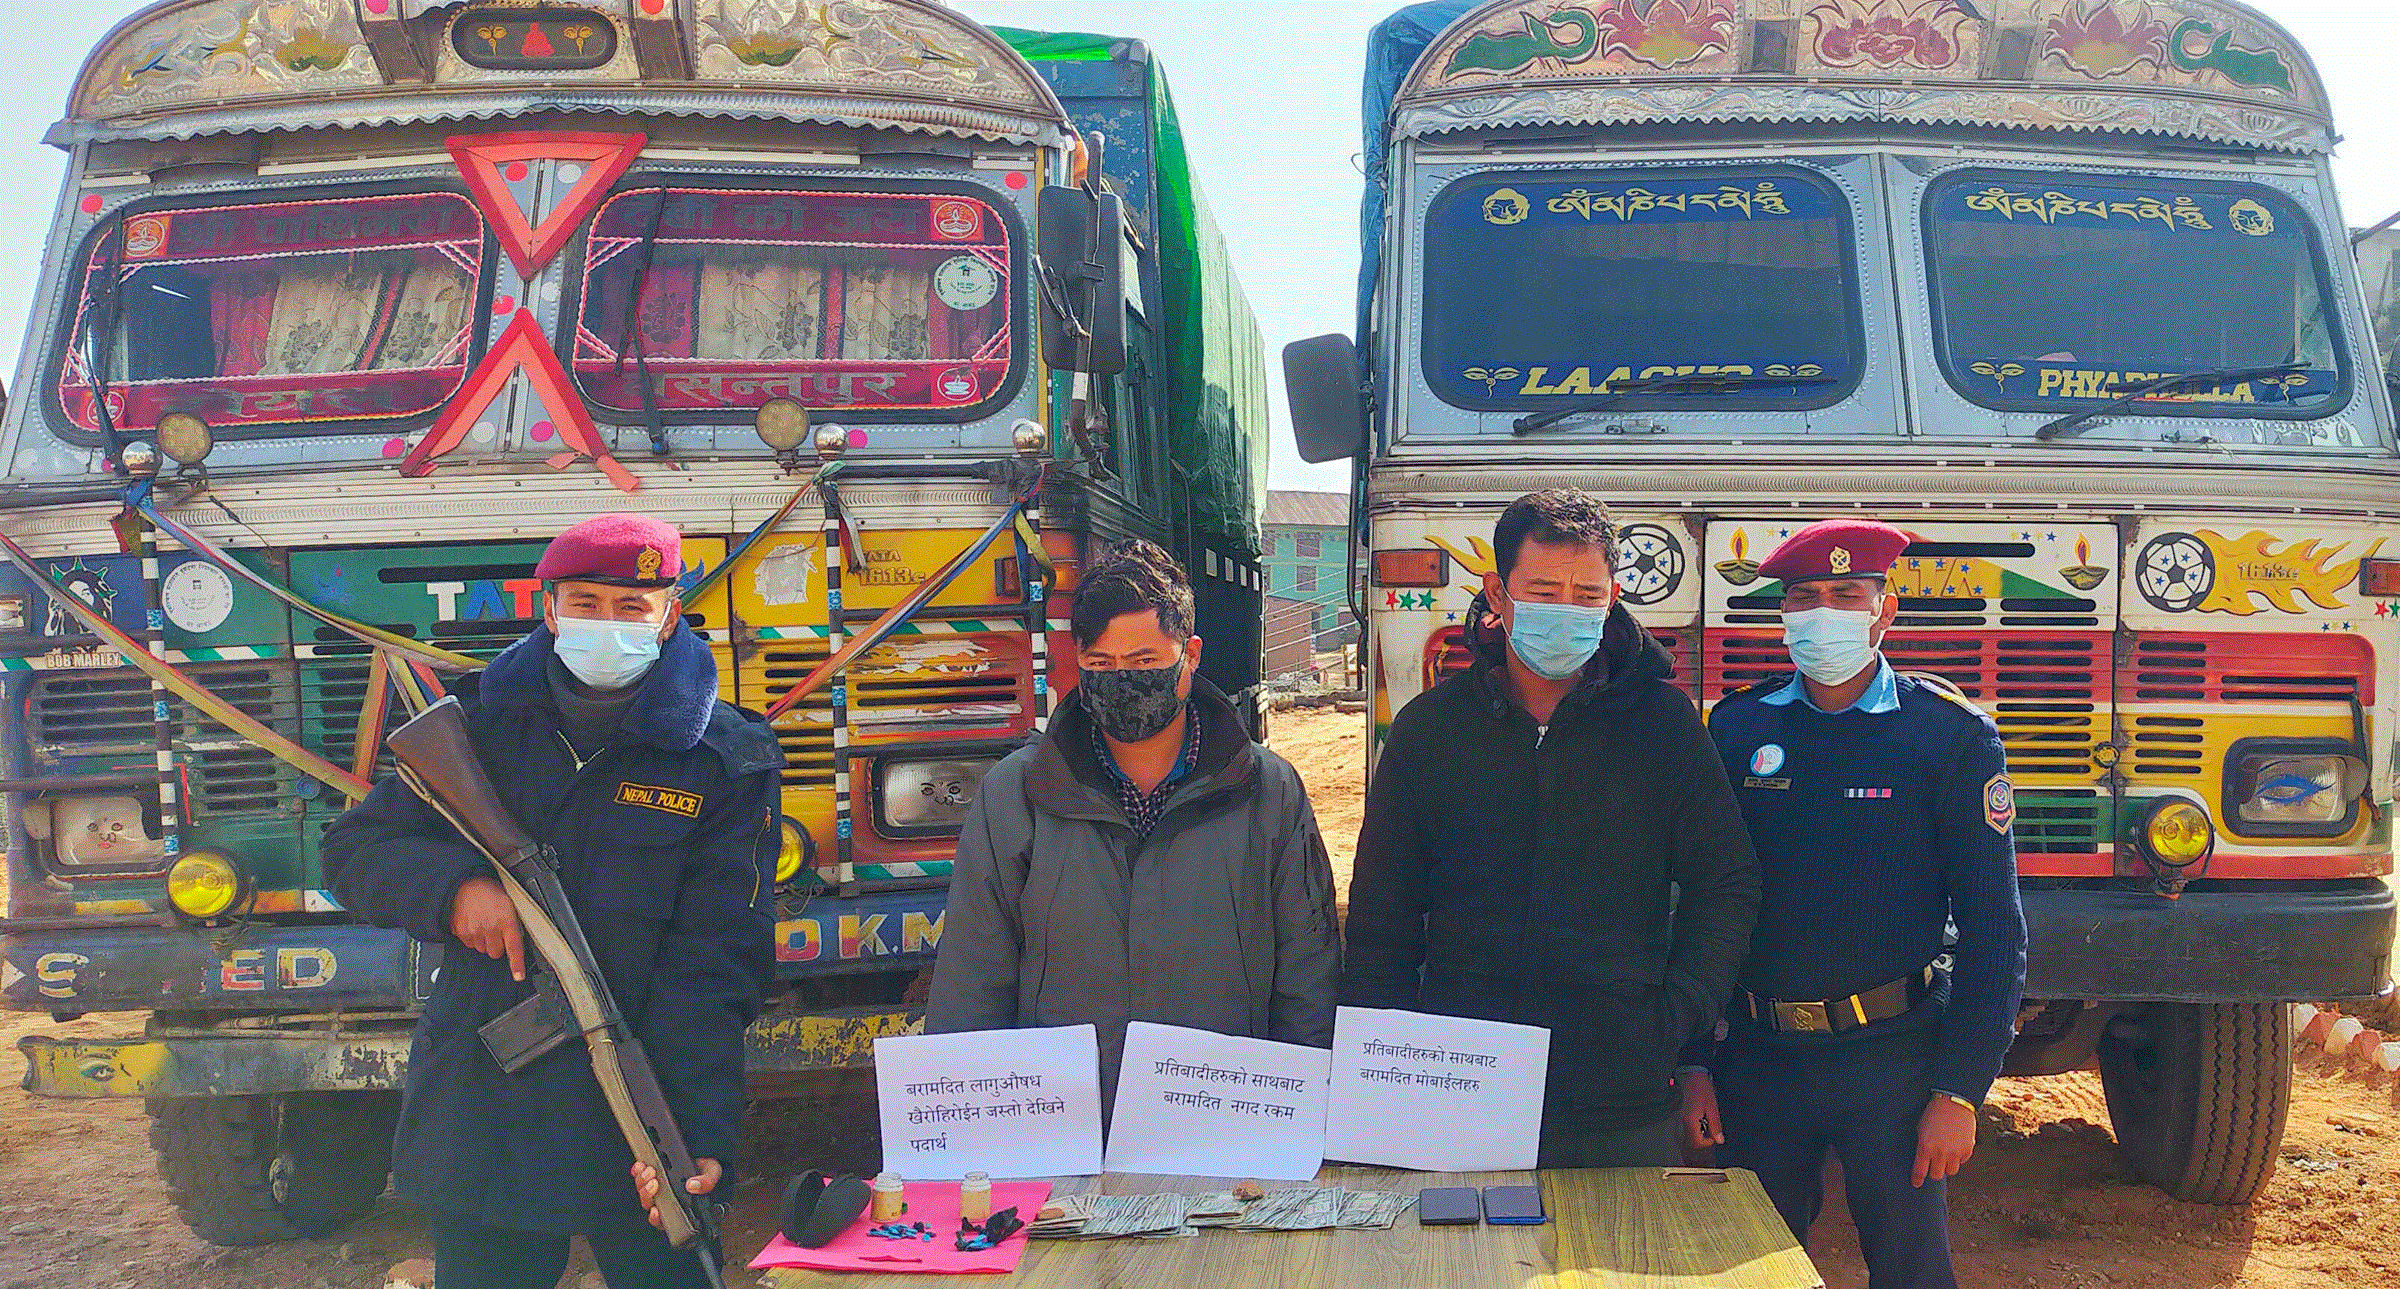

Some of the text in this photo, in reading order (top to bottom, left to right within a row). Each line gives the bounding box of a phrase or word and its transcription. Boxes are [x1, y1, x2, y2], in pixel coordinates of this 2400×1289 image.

[733, 197, 807, 232] की
[823, 204, 920, 234] जय
[426, 578, 543, 621] TAT
[46, 651, 121, 669] BOB MARLEY
[622, 786, 698, 814] NEPAL POLICE
[1449, 1050, 1498, 1068] साथबाट
[1251, 1073, 1305, 1093] साथबाट
[984, 1099, 1022, 1118] जस्तो
[1025, 1096, 1066, 1115] देखिने
[1230, 1099, 1261, 1116] नगद
[1264, 1103, 1296, 1120] रकम
[909, 1132, 947, 1152] पदार्थ
